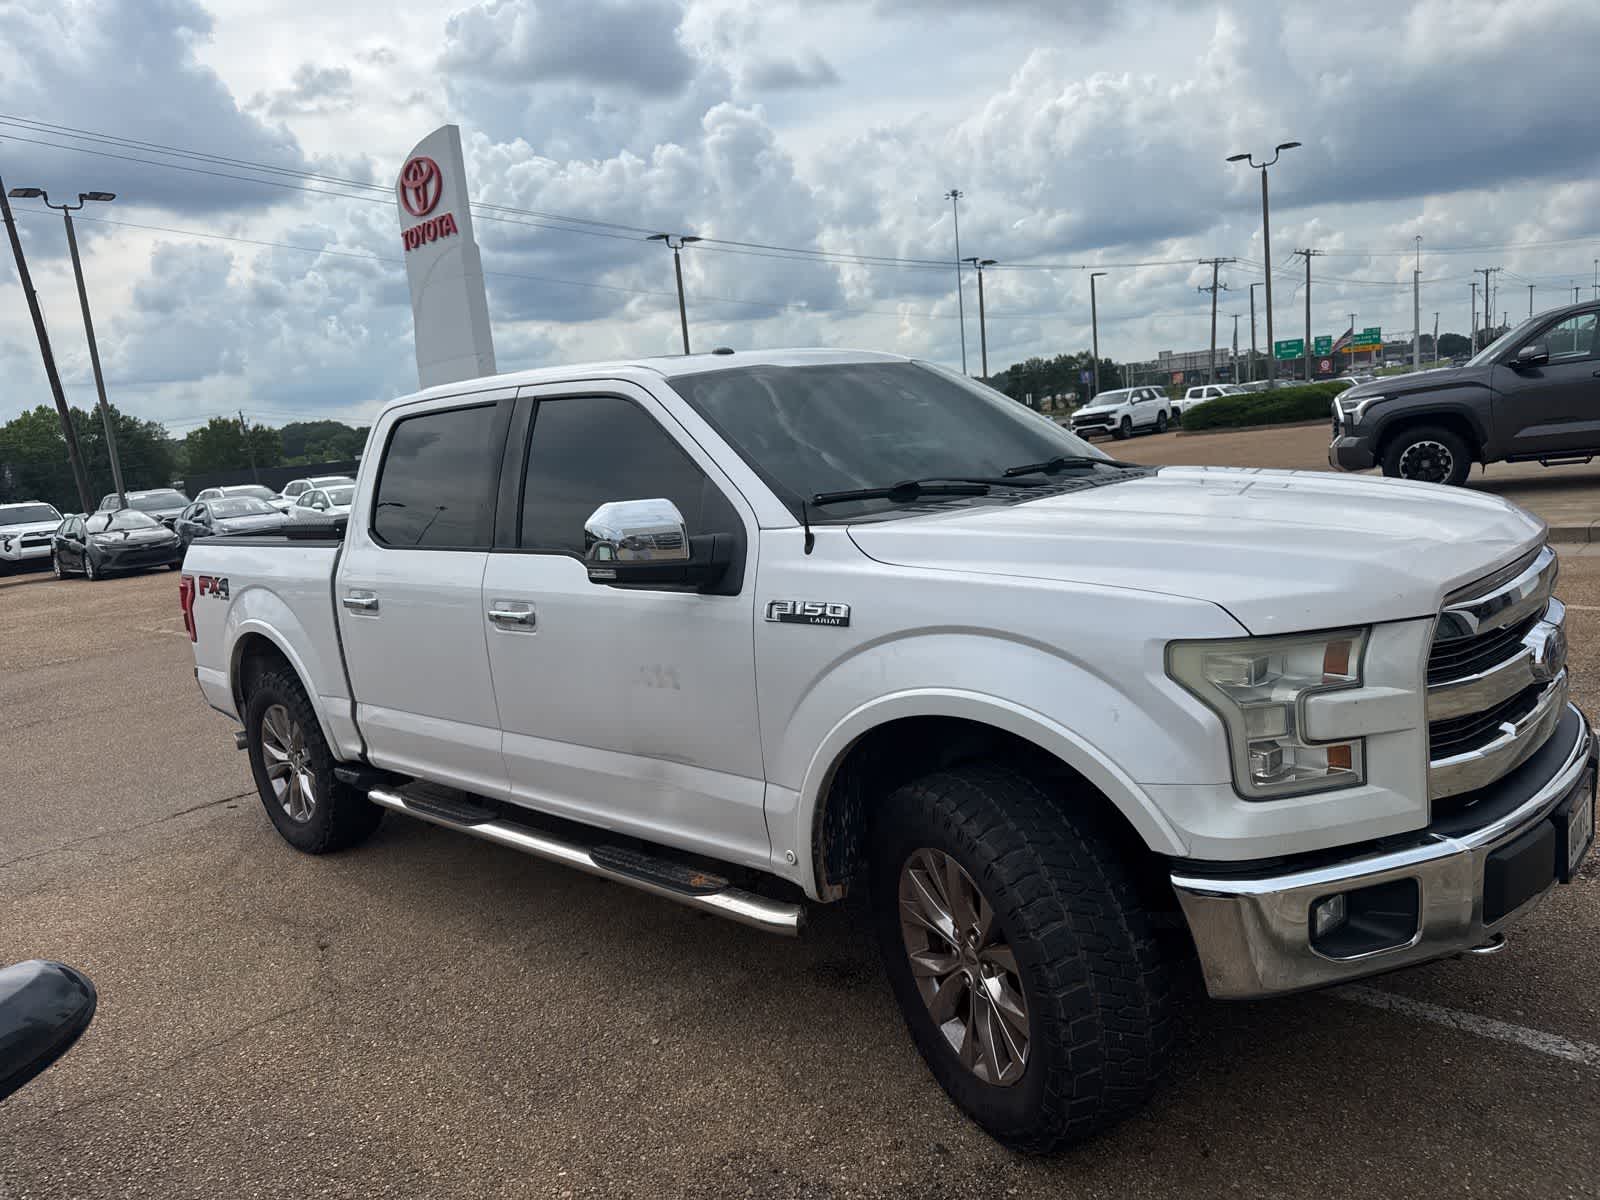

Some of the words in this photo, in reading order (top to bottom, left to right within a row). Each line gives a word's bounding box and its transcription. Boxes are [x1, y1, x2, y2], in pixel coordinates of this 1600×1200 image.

[401, 212, 458, 251] TOYOTA
[199, 575, 229, 596] FX4
[809, 616, 841, 625] LARIAT
